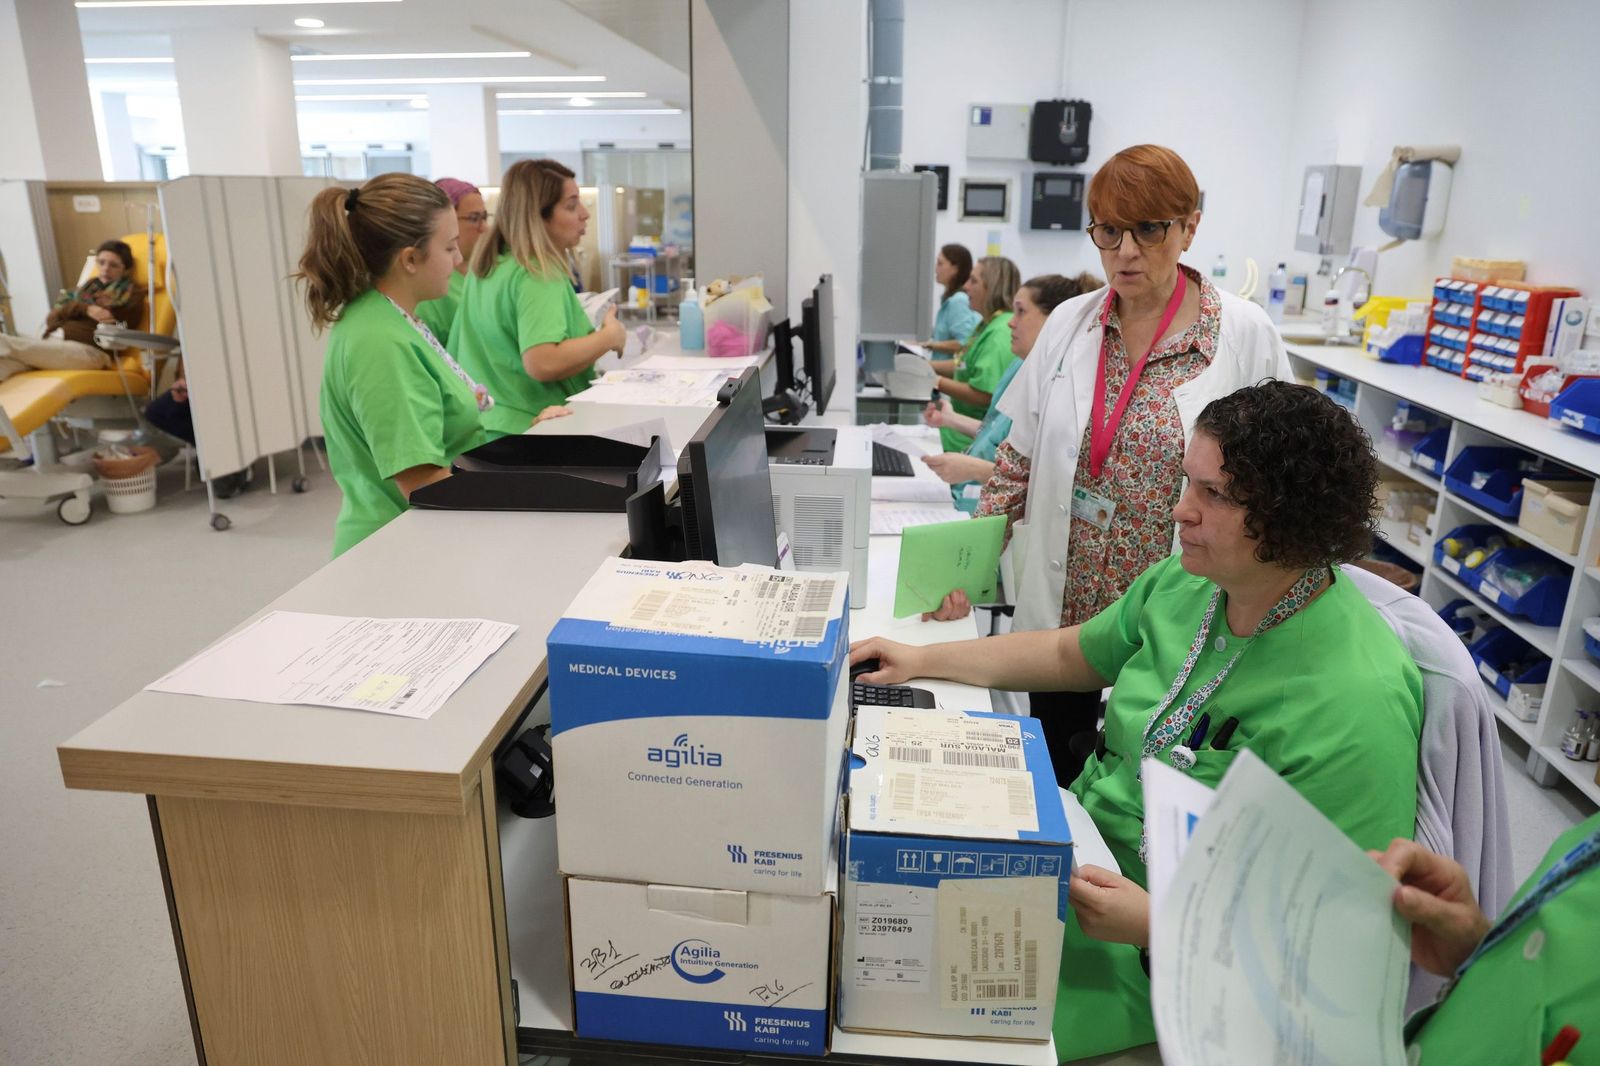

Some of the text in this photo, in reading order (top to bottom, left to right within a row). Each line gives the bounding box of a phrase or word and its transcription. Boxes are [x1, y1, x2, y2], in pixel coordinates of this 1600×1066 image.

[569, 663, 677, 680] MEDICAL DEVICES
[965, 745, 1006, 753] MALAGA
[647, 744, 722, 768] agilia
[627, 771, 743, 790] Connected Generation
[754, 850, 803, 861] FRESENIUS
[754, 858, 776, 866] KABI
[753, 867, 803, 878] caring for life
[871, 916, 908, 925] Z019680
[871, 925, 913, 934] 23976479
[680, 945, 721, 959] Agilia
[680, 958, 759, 970] Intuitive Generation
[754, 1017, 810, 1028] FRESENIUS
[754, 1026, 780, 1035] KABI
[754, 1037, 810, 1047] caring for life
